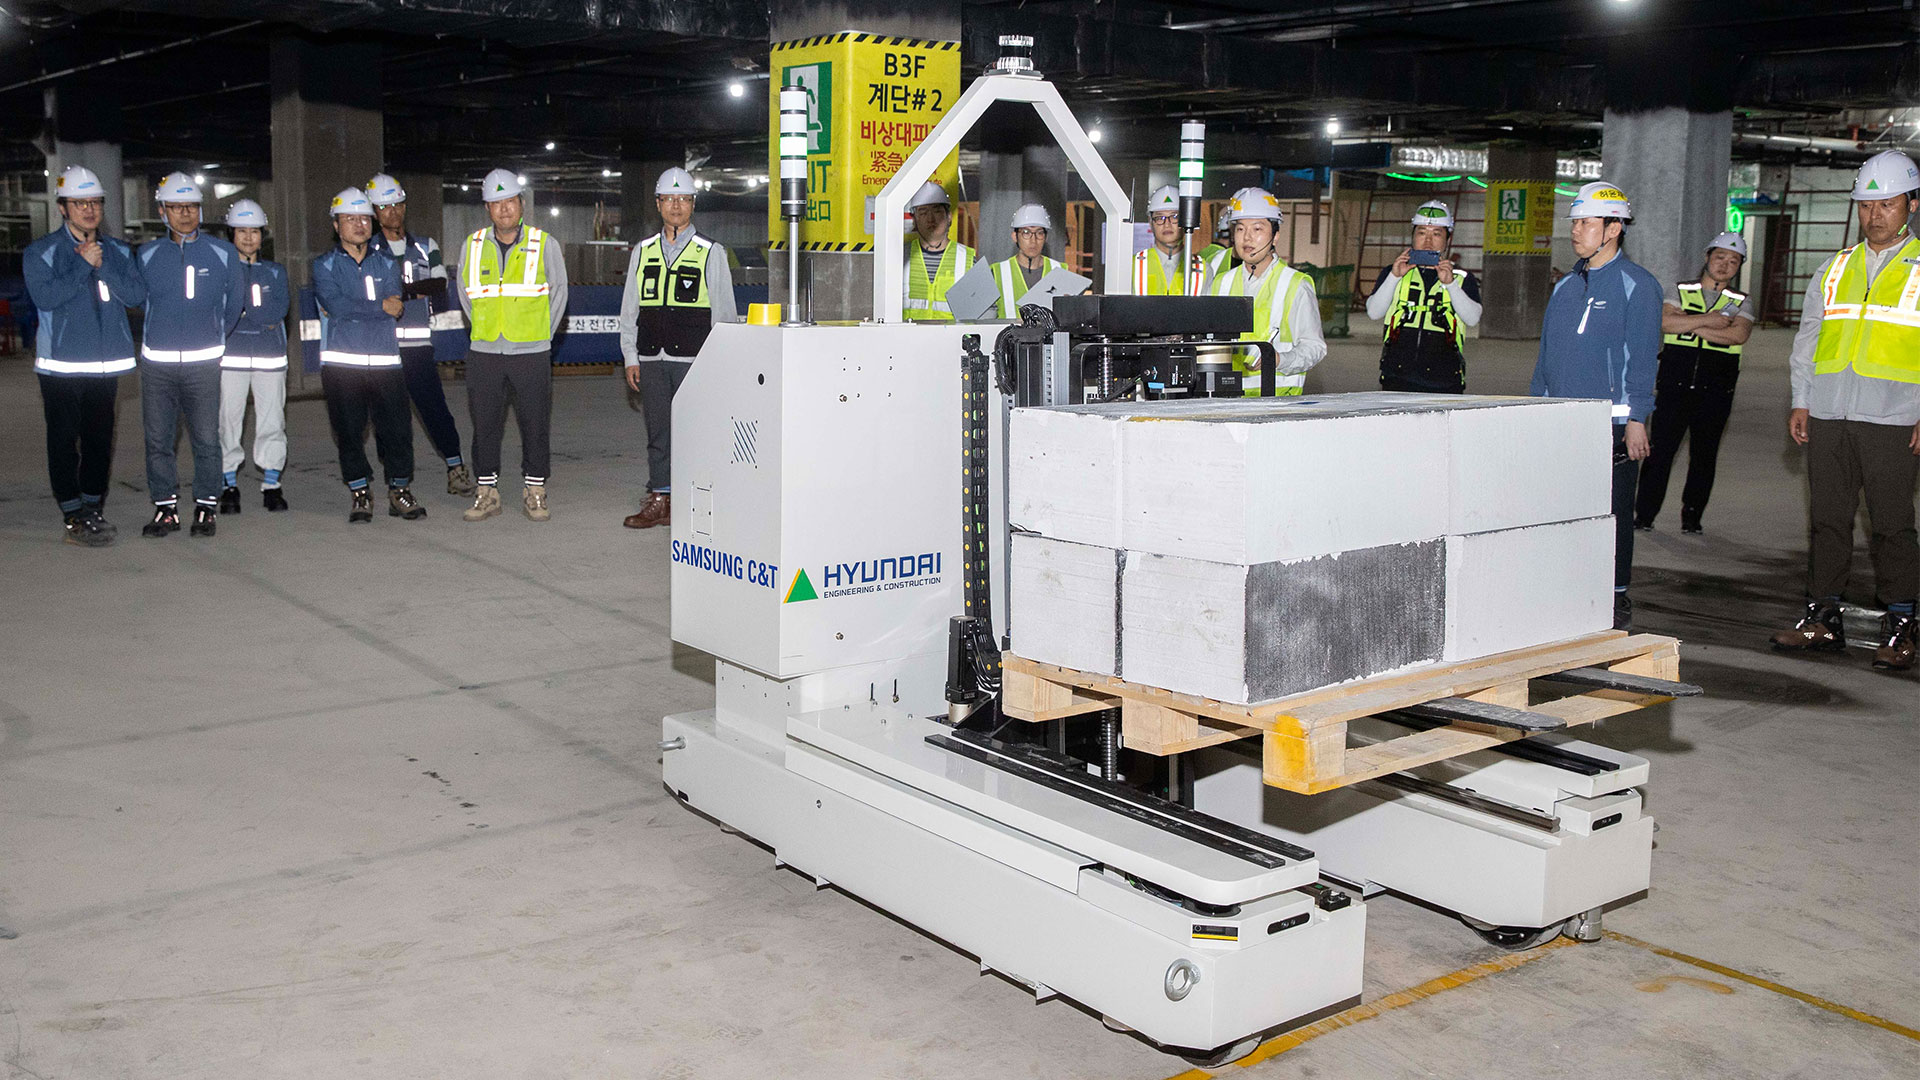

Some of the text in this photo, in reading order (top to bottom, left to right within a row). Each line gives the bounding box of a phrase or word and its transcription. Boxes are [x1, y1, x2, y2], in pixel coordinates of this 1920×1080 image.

[884, 53, 926, 78] B3F
[861, 120, 937, 147] 비상대피
[1497, 222, 1525, 235] EXIT
[672, 539, 778, 589] SAMSUNG C&T
[823, 552, 942, 588] HYUNDAI
[823, 577, 942, 599] ENGINEERING & CONSTRUCTION
